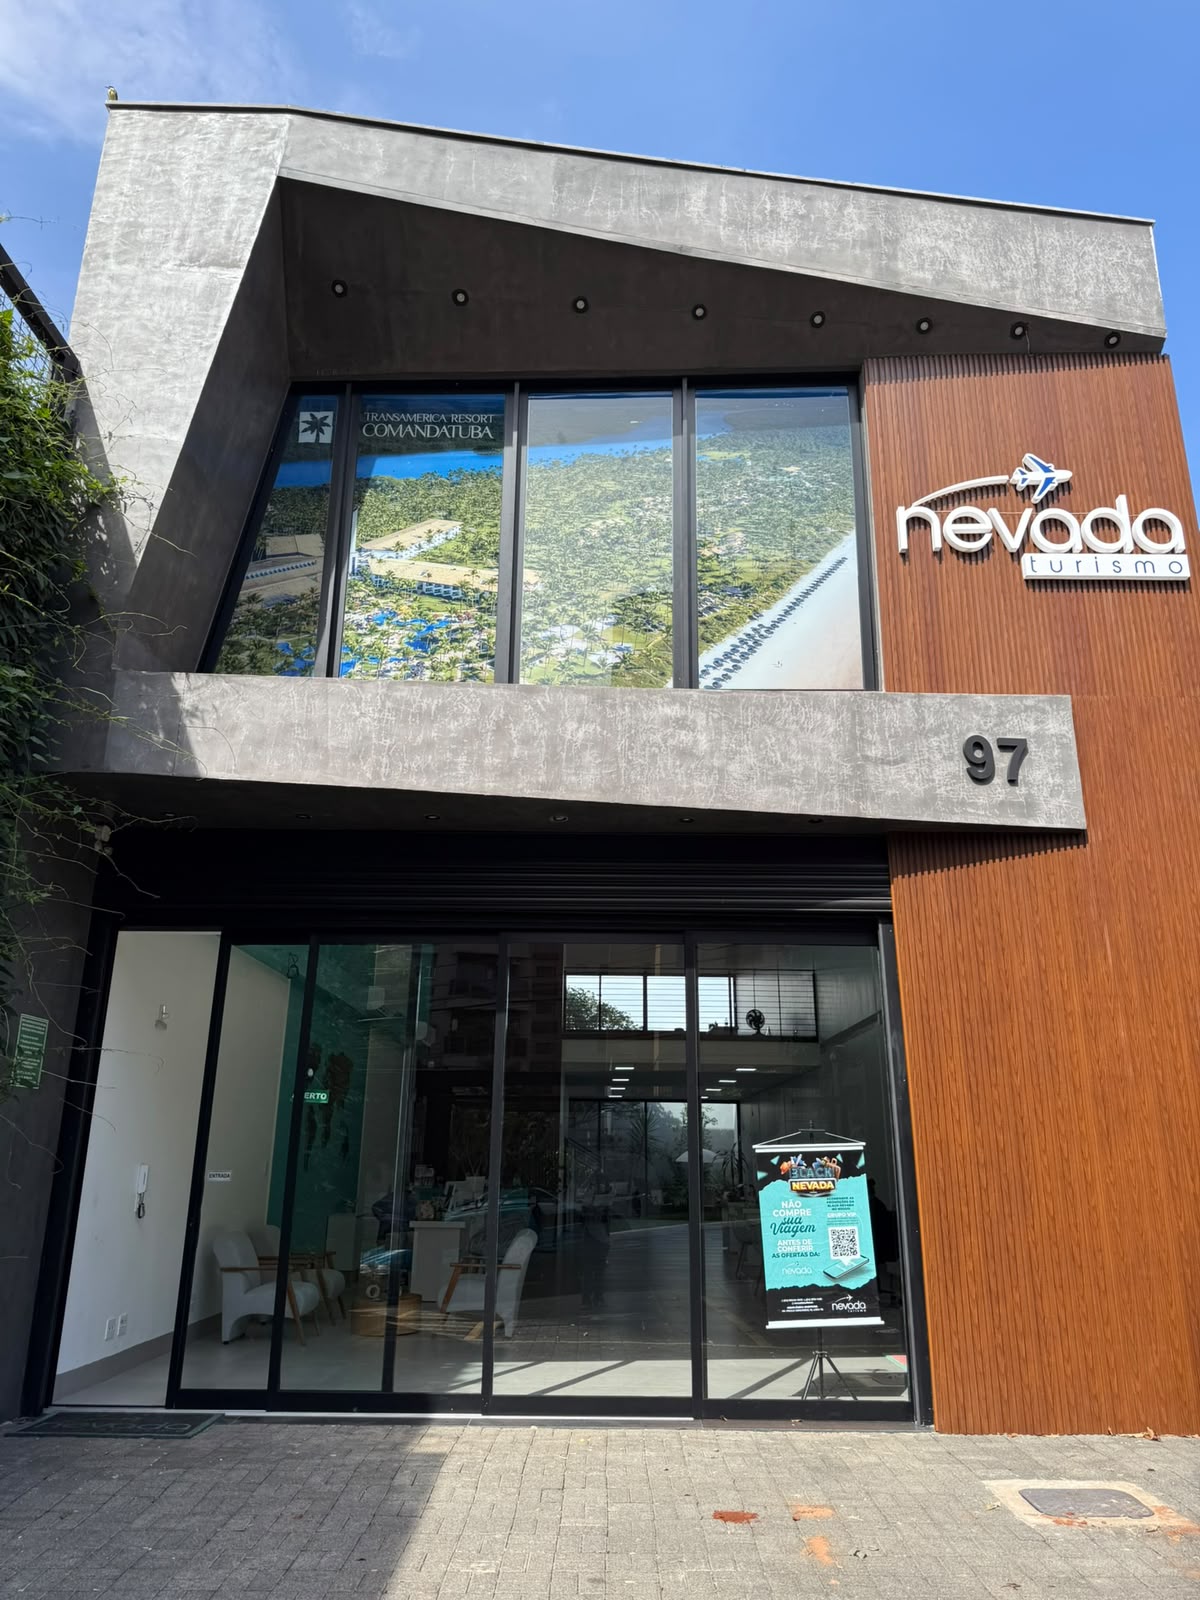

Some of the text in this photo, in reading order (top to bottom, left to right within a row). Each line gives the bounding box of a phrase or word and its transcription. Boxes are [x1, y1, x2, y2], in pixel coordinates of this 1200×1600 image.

[364, 412, 494, 424] TRANSAMERICA RESORT
[362, 422, 494, 440] COMANDATUBA
[896, 494, 1186, 554] nevada
[1029, 556, 1184, 574] turismo
[962, 734, 1029, 787] 97
[291, 1091, 328, 1100] ERTO
[790, 1167, 833, 1178] BLACK
[791, 1180, 835, 1190] NEVADA
[781, 1199, 802, 1209] NÃO
[772, 1208, 812, 1217] COMPRE
[781, 1216, 803, 1225] sua
[770, 1222, 816, 1238] Viagem
[831, 1300, 867, 1311] nevada
